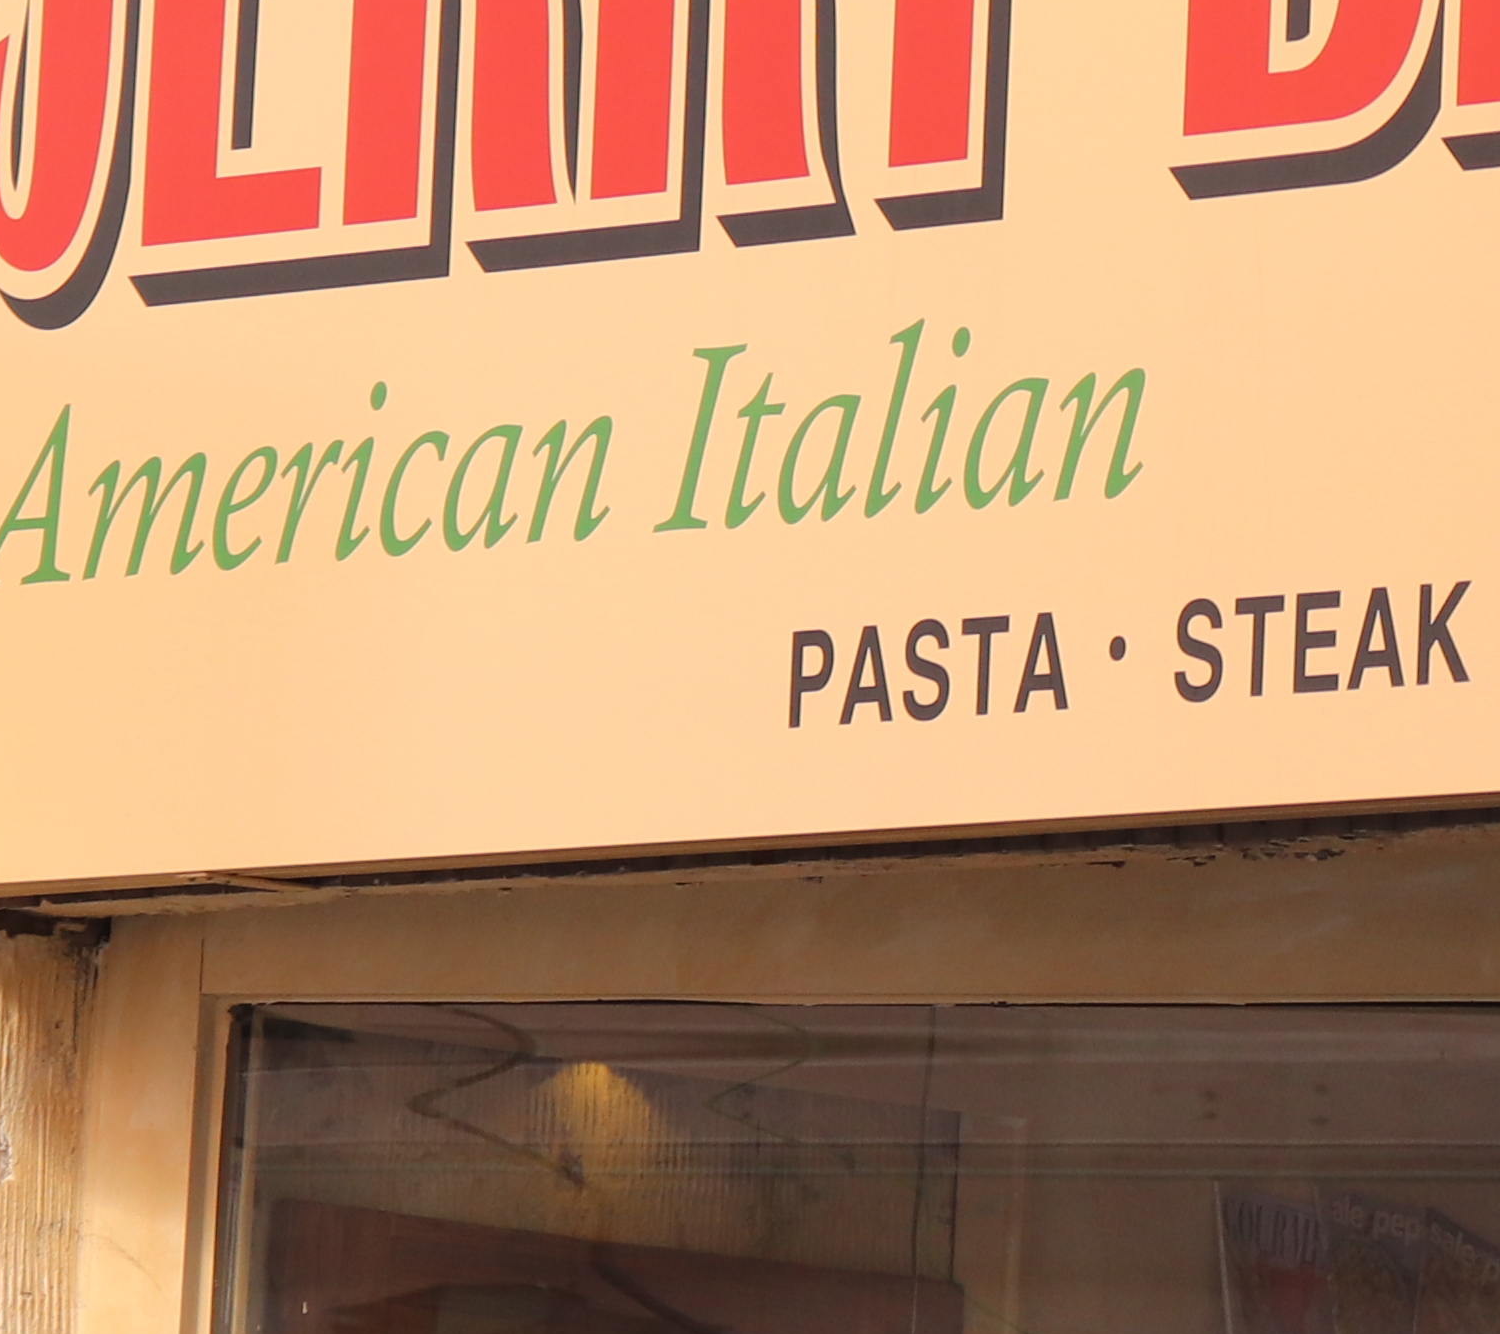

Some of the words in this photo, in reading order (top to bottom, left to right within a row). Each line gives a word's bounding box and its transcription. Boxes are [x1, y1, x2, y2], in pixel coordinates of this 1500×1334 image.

[654, 318, 1147, 534] Italian
[788, 611, 1068, 728] PASTA
[1174, 580, 1472, 702] STEAK
[1330, 1196, 1364, 1228] ale
[1372, 1210, 1421, 1247] pep
